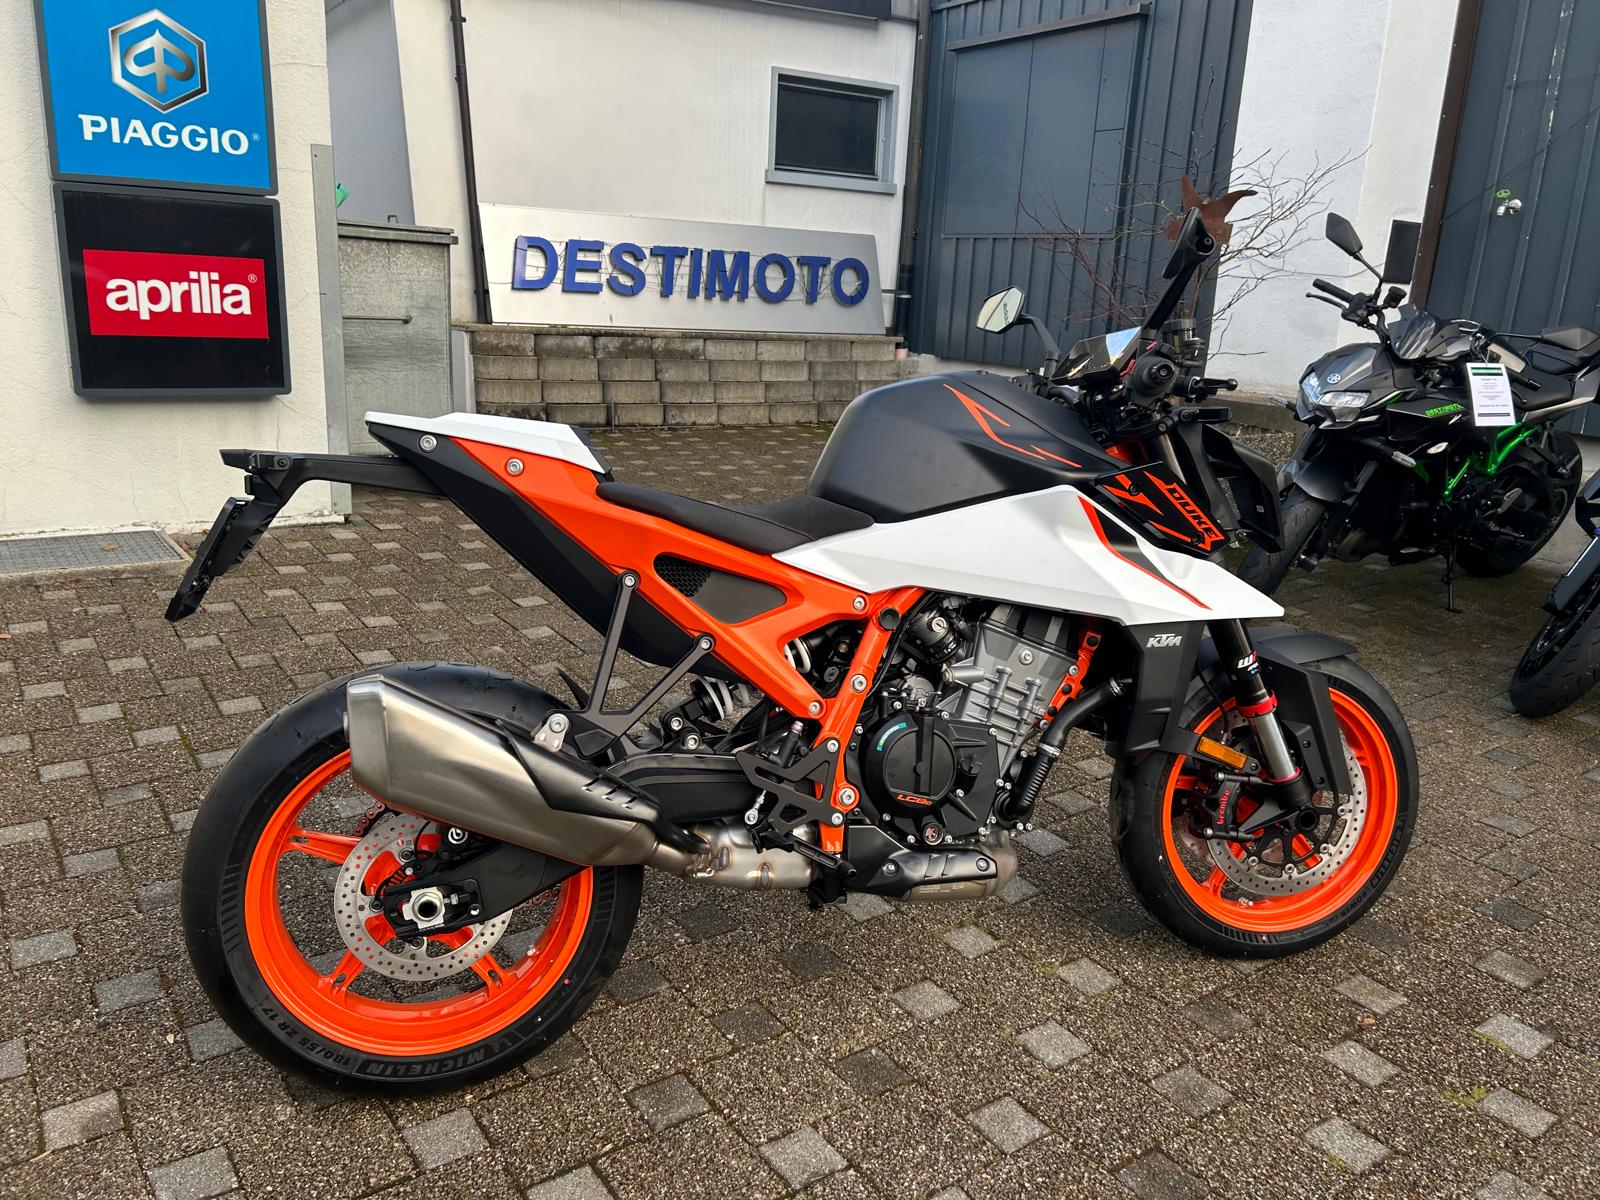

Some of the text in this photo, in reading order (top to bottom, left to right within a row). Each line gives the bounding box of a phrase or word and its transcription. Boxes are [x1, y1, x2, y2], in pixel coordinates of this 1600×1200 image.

[78, 114, 249, 155] PIAGGIO
[512, 235, 870, 306] DESTIMOTO
[105, 270, 252, 320] aprilia
[1166, 487, 1220, 539] DUKE
[1146, 633, 1183, 648] KTM
[1217, 789, 1231, 825] brembo
[261, 1006, 351, 1066] 180/55 ZR 17
[366, 1047, 485, 1076] MICHELIN
